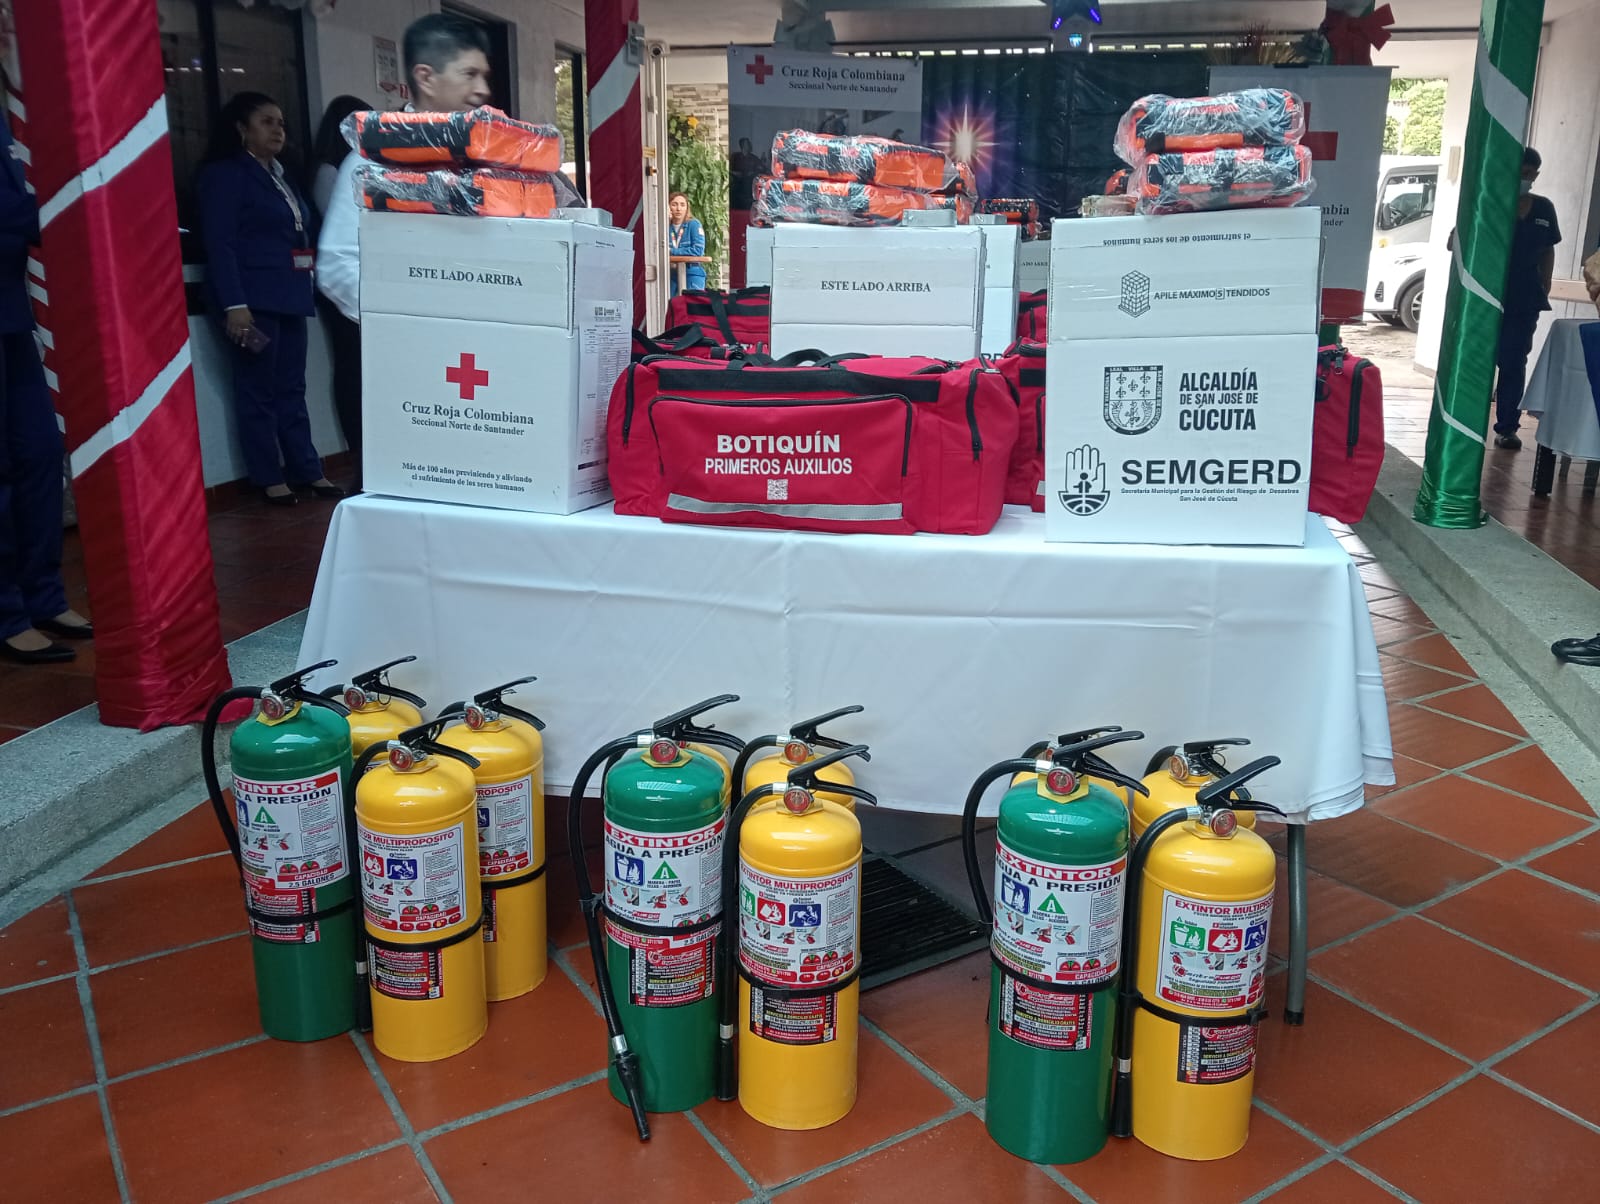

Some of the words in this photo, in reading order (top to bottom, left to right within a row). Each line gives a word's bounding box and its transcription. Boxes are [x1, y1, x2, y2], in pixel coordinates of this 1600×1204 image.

[781, 65, 809, 77] Cruz
[812, 67, 838, 80] Roja
[841, 67, 905, 82] Colombiana
[788, 81, 824, 90] Seccional
[826, 83, 847, 92] Norte
[849, 84, 858, 92] de
[860, 85, 899, 94] Santander
[408, 266, 438, 279] ESTE
[440, 269, 474, 282] LADO
[476, 273, 523, 286] ARRIBA
[821, 280, 849, 290] ESTE
[852, 281, 885, 291] LADO
[886, 282, 931, 292] ARRIBA
[1154, 291, 1177, 300] APILE
[1226, 288, 1270, 298] TENDIDOS
[1179, 367, 1258, 391] ALCALDÍA
[1180, 394, 1192, 405] DE
[1195, 393, 1215, 405] SAN
[1218, 390, 1243, 405] JOSÉ
[1246, 393, 1259, 404] DE
[402, 401, 431, 414] Cruz
[434, 404, 461, 419] Roja
[464, 407, 534, 425] Colombiana
[1179, 405, 1256, 431] CÚCUTA
[411, 416, 447, 428] Seccional
[449, 420, 471, 431] Norte
[473, 423, 482, 432] de
[483, 423, 525, 436] Santander
[717, 430, 840, 455] BOTIQUÍN
[402, 462, 416, 471] Más
[417, 464, 426, 472] de
[427, 465, 439, 473] 100
[440, 466, 455, 475] años
[456, 469, 495, 479] previniendo
[501, 473, 533, 483] aliviando
[705, 458, 780, 475] PRIMEROS
[784, 458, 853, 475] AUXILIOS
[1121, 459, 1301, 485] SEMGERD
[418, 474, 456, 485] sufrimiento
[457, 478, 465, 486] de
[466, 479, 475, 487] los
[477, 480, 493, 488] seres
[494, 482, 525, 492] humanos
[1151, 488, 1179, 496] Municipal
[1236, 488, 1257, 496] Riesgo
[257, 787, 331, 804] PRESIÓN
[261, 811, 268, 823] A
[373, 832, 455, 846] MULTIPROPOSITO
[606, 835, 635, 855] AGUA
[641, 850, 652, 858] A
[659, 832, 722, 858] PRESIÓN
[611, 827, 716, 847] EXTINTOR
[660, 867, 670, 879] A
[1000, 849, 1112, 880] EXTINTOR
[294, 869, 328, 880] CAPACIDAD
[302, 873, 335, 886] GALONES
[774, 872, 853, 890] MULTIPROPOSITO
[1028, 878, 1039, 887] A
[1047, 875, 1120, 892] PRESIÓN
[1047, 900, 1056, 912] A
[1175, 899, 1231, 914] EXTINTOR
[1075, 969, 1107, 980] CAPACIDAD
